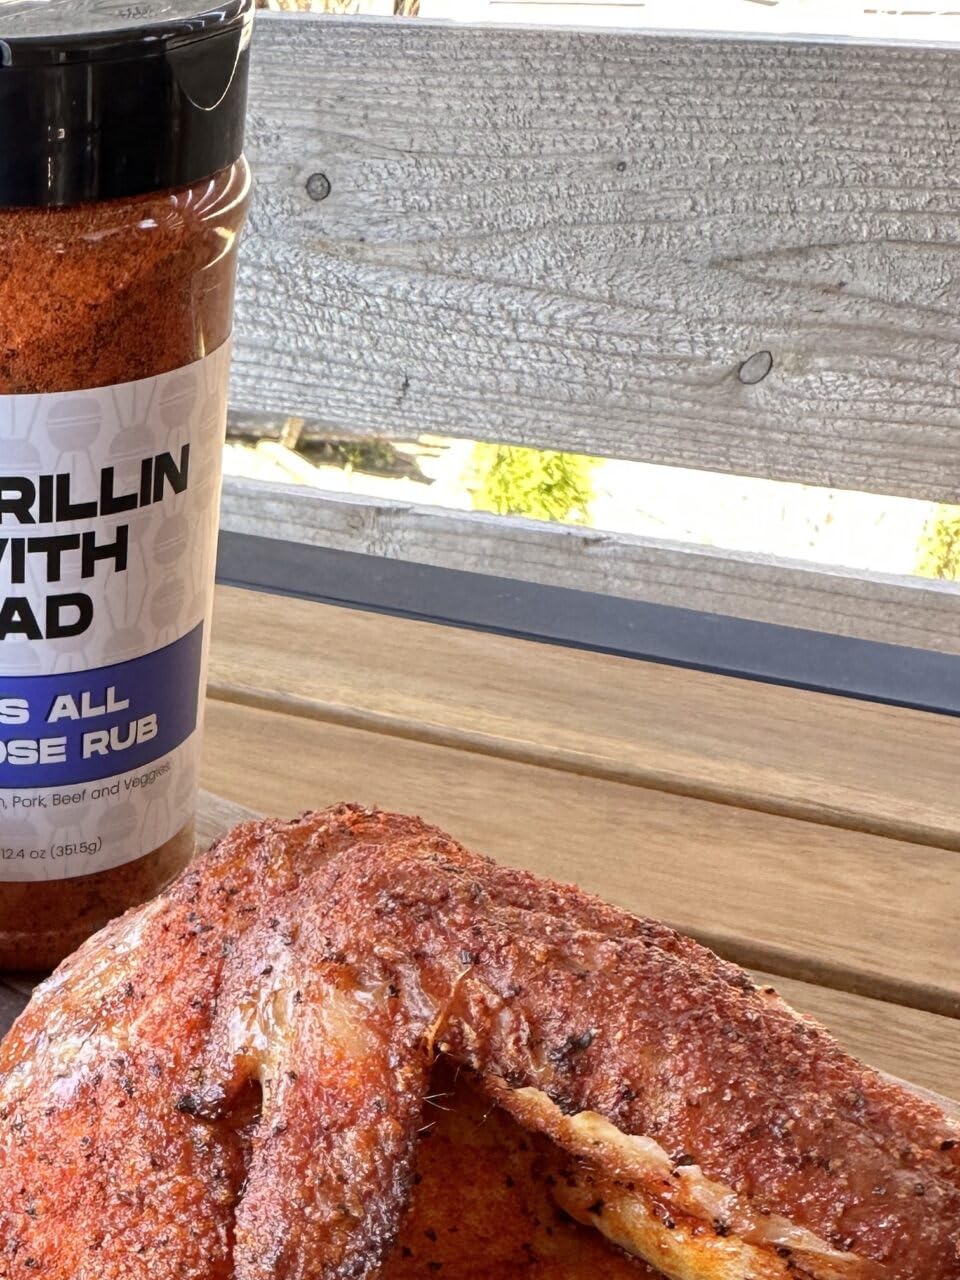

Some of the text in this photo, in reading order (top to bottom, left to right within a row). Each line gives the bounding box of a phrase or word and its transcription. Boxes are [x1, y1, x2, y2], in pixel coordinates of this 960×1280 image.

[46, 685, 130, 723] ALL
[82, 712, 159, 760] RUB
[52, 788, 87, 807] Beef
[91, 780, 120, 800] and
[123, 761, 171, 791] Veggies
[29, 849, 46, 860] oz
